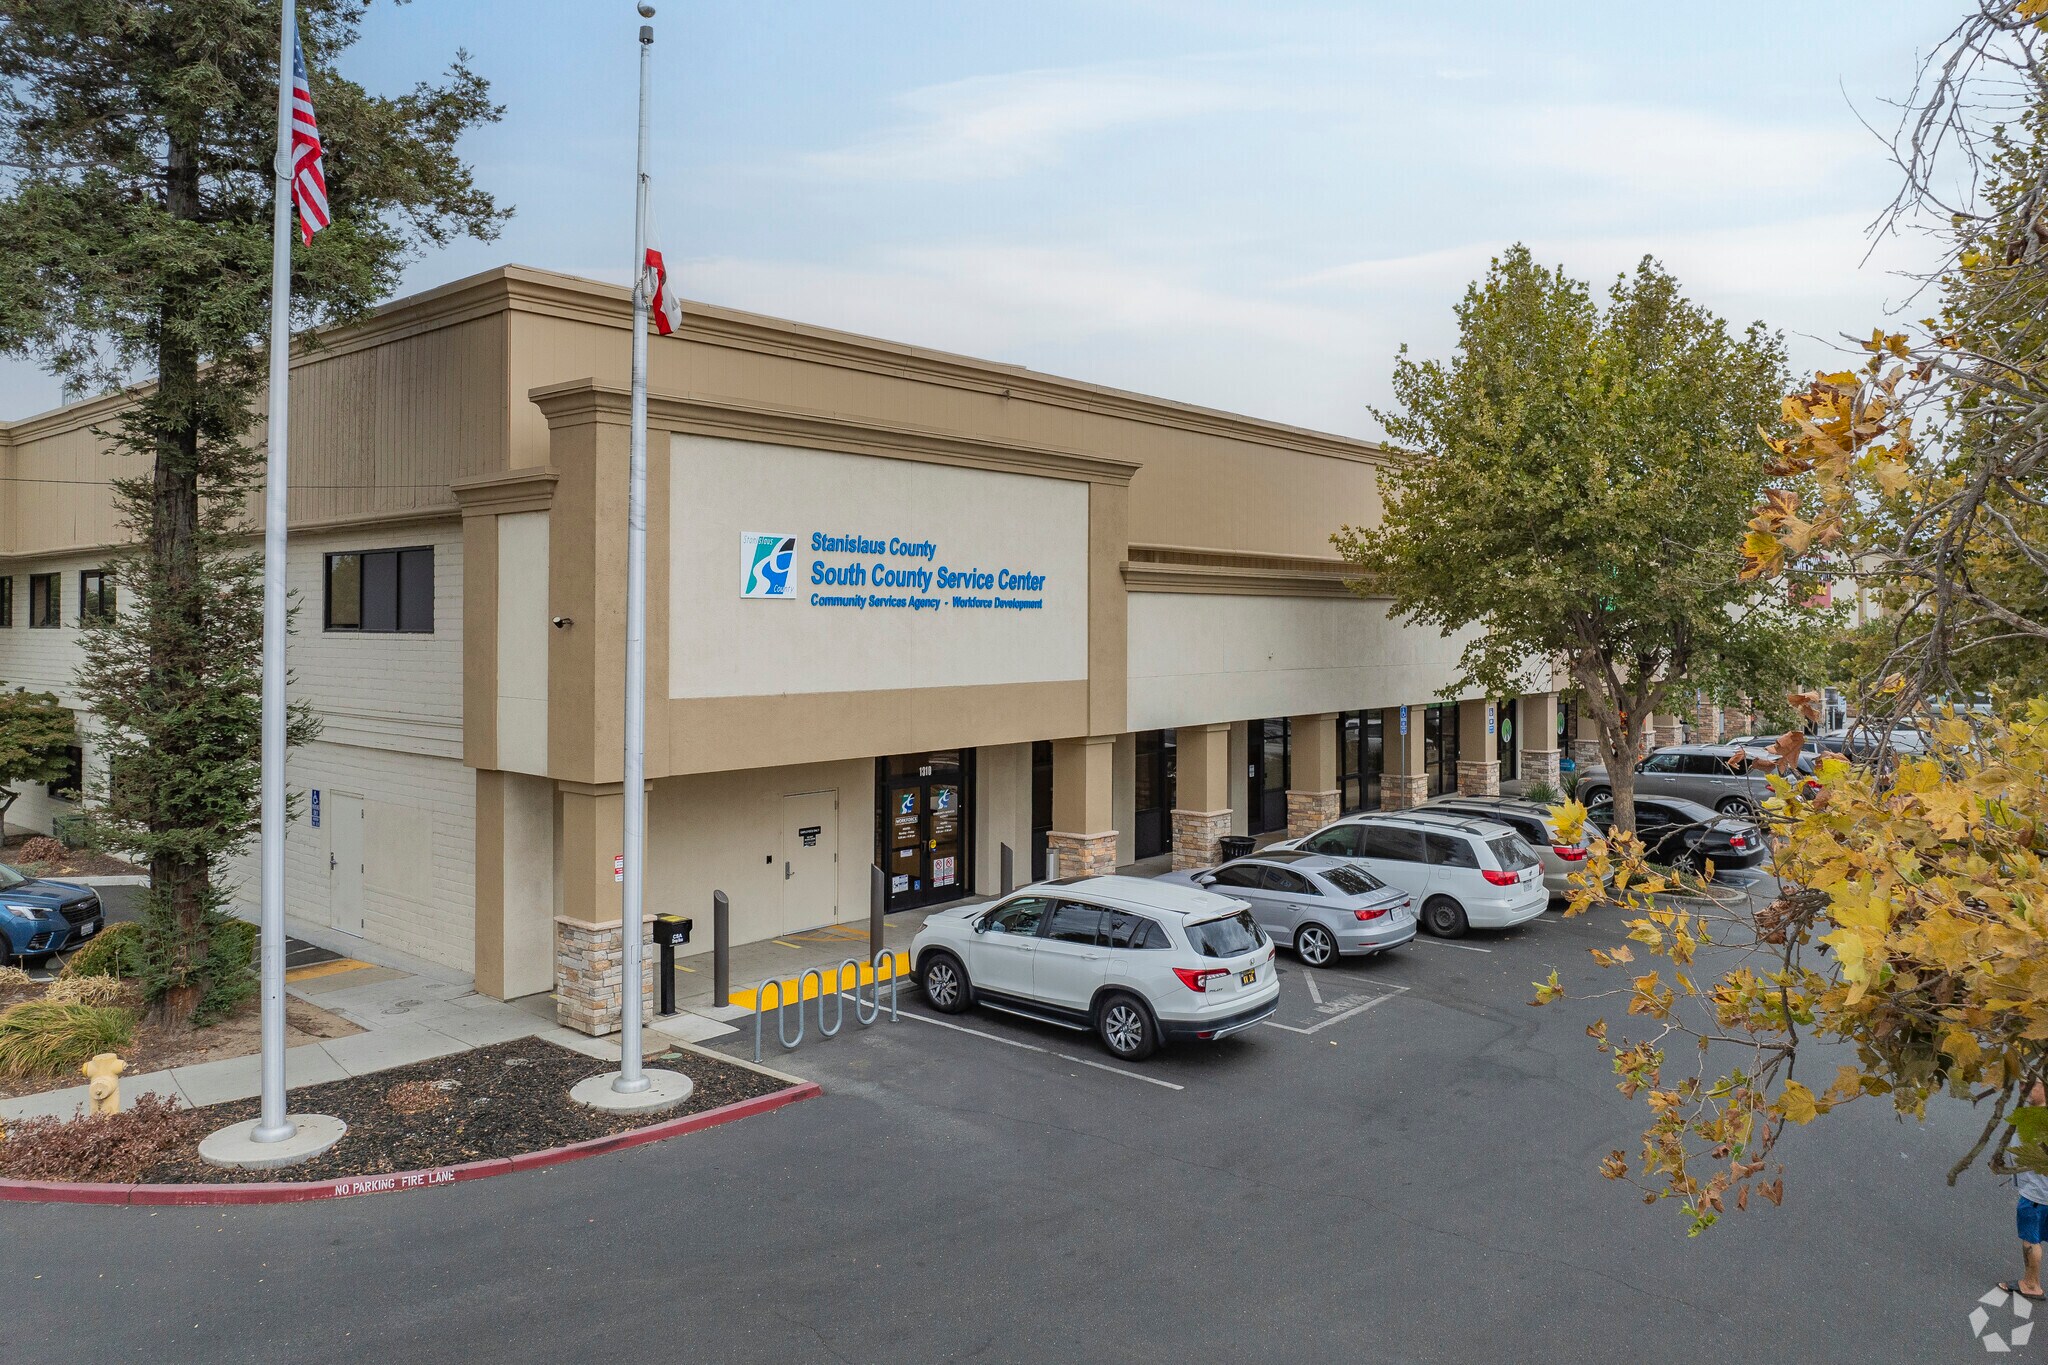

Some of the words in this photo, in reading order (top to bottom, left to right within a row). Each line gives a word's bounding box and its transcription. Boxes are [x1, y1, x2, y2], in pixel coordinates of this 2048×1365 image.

[811, 532, 886, 555] Stanislaus
[889, 537, 937, 561] County
[811, 560, 867, 586] South
[871, 563, 933, 594] County
[936, 566, 995, 590] Service
[998, 568, 1046, 591] Center
[811, 593, 867, 610] Community
[868, 594, 907, 608] Services
[908, 595, 941, 611] Agency
[952, 596, 993, 609] Workforce
[994, 596, 1043, 611] Development
[919, 766, 932, 777] 1310
[335, 1184, 350, 1196] NO
[352, 1178, 395, 1194] PARKING
[401, 1174, 425, 1187] FIRE
[428, 1169, 456, 1184] LANE
